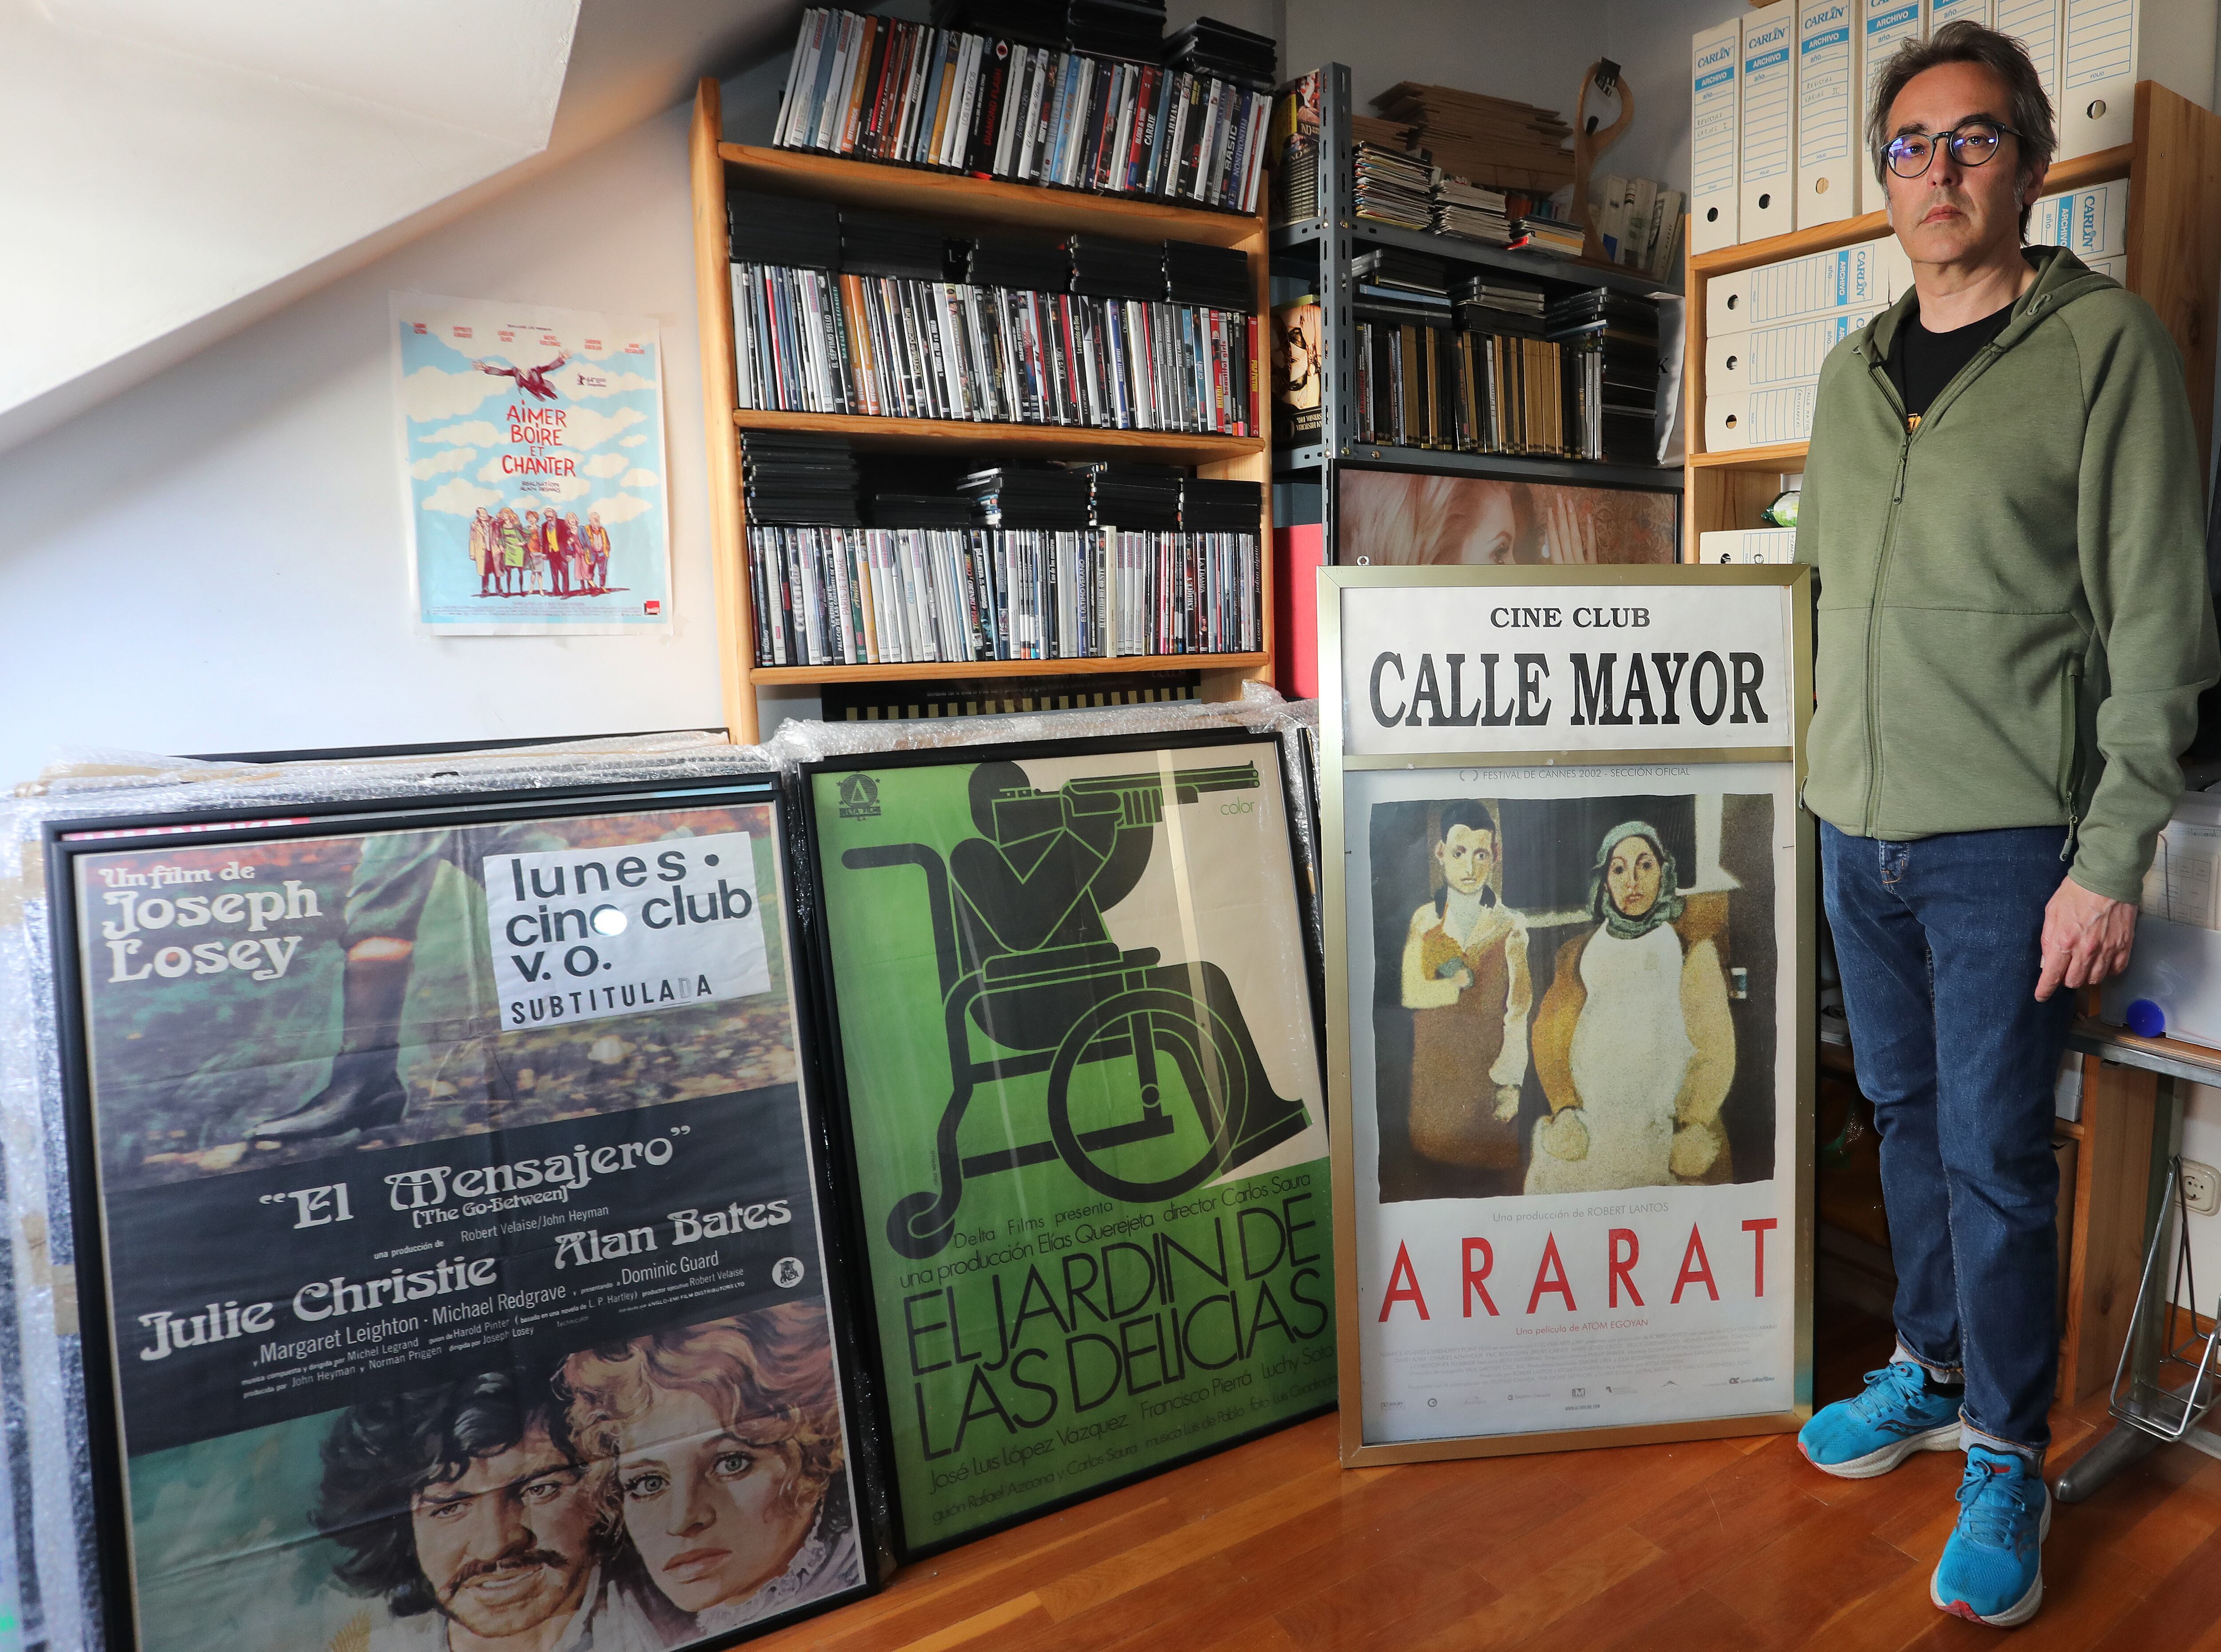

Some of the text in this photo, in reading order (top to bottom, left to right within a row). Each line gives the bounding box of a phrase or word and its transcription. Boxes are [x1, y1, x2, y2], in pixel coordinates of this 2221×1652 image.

[1805, 6, 1844, 29] CARLIN
[1876, 11, 1909, 29] ARCHIVO
[1749, 27, 1786, 48] CARLIN
[1809, 32, 1839, 48] ARCHIVO
[1878, 34, 1890, 43] año
[1698, 47, 1731, 68] CARLIN
[1753, 52, 1781, 68] ARCHIVO
[1701, 72, 1727, 87] ARCHIVO
[1703, 91, 1712, 100] año
[983, 68, 1002, 146] DIAMOND FLASH
[1168, 103, 1178, 135] ARMAS
[1134, 126, 1143, 144] BLOOD
[1143, 113, 1156, 146] CARRIE
[1224, 124, 1238, 171] BASIC
[2083, 195, 2095, 248] CARLIN
[824, 314, 833, 333] SELLO
[855, 368, 865, 401] HITCHCOCK
[867, 369, 877, 402] HITCHCOCK
[502, 454, 576, 477] CHANTER
[530, 446, 543, 457] ET
[791, 585, 805, 632] Cotton
[906, 581, 915, 604] clase
[967, 580, 976, 605] DINERO
[1491, 608, 1651, 628] CINE CLUB
[1369, 650, 1768, 728] CALLE MAYOR
[1483, 766, 1690, 780] FESTIVAL DE CANNES 2002 SECCIÓN OFICIAL
[1221, 796, 1254, 815] color
[100, 862, 255, 889] Un film de
[511, 851, 686, 901] lunes
[102, 880, 323, 939] Joseph
[641, 879, 752, 929] club
[107, 935, 303, 983] Losey
[511, 974, 712, 1024] SUBTITULADA
[954, 1202, 1113, 1249] Delta Films presenta
[1493, 1203, 1669, 1222] Una producción de ROBERT LANTOS
[374, 1205, 609, 1259] una producción de Robert Velaise/John Heyman
[555, 1199, 792, 1270] Alan Bates
[900, 1173, 1310, 1289] una producción Elías Querejeta director Carlos Saura
[903, 1192, 1320, 1376] EL JARDIN DE
[1378, 1218, 1777, 1322] ARARAT
[138, 1256, 497, 1361] Julie Christie
[260, 1250, 719, 1364] Margaret Leighton Michael Redgrave Dominic Guard
[1516, 1319, 1648, 1336] Una película de ATOM EGOYAN
[915, 1268, 1328, 1461] LAS DELICIAS
[931, 1463, 968, 1495] José
[973, 1457, 1000, 1475] Luis
[1003, 1439, 1055, 1466] López
[1141, 1388, 1210, 1420] Francisco
[1262, 1355, 1299, 1379] Luchy
[1303, 1346, 1333, 1365] Soto
